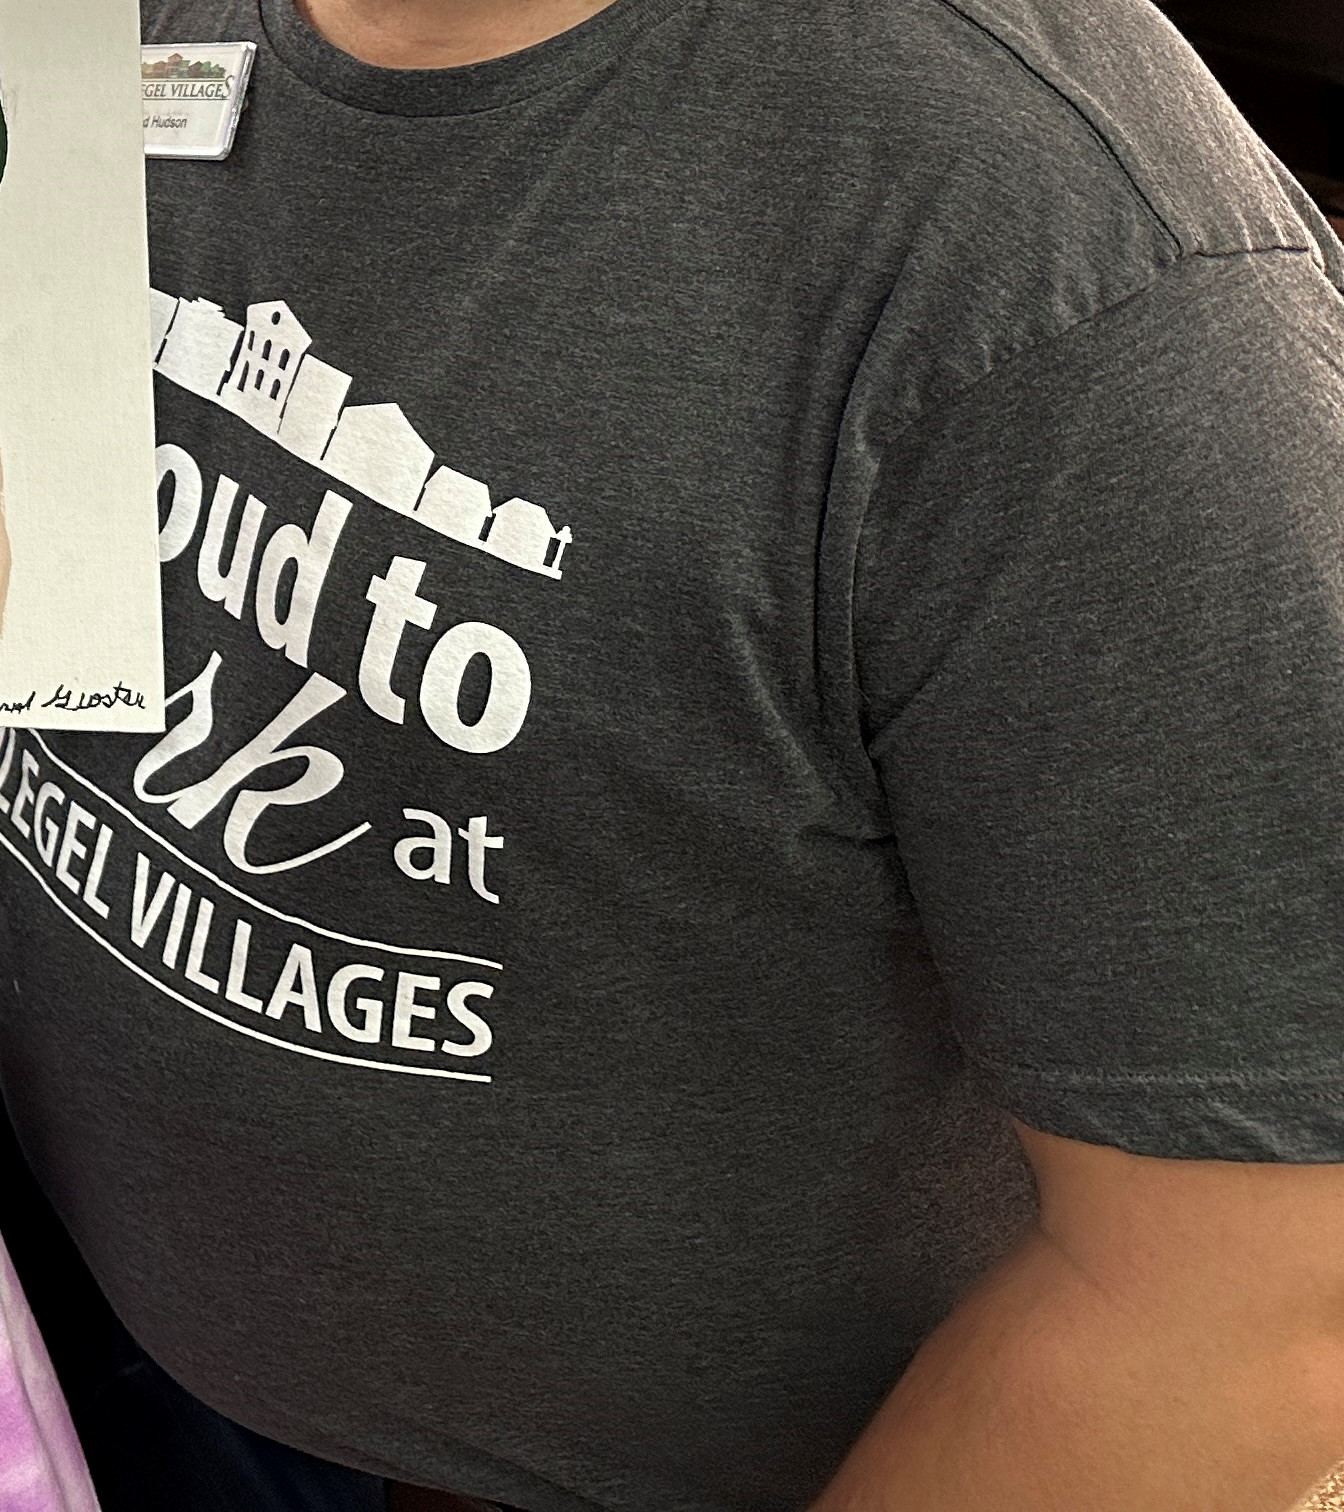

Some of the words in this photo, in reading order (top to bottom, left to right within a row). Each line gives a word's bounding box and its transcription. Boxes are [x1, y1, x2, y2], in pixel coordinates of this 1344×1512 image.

[151, 116, 188, 129] Hudson
[171, 75, 234, 99] VILLAGES
[358, 555, 532, 754] to
[393, 808, 505, 905] at
[130, 851, 495, 1058] VILLAGES
